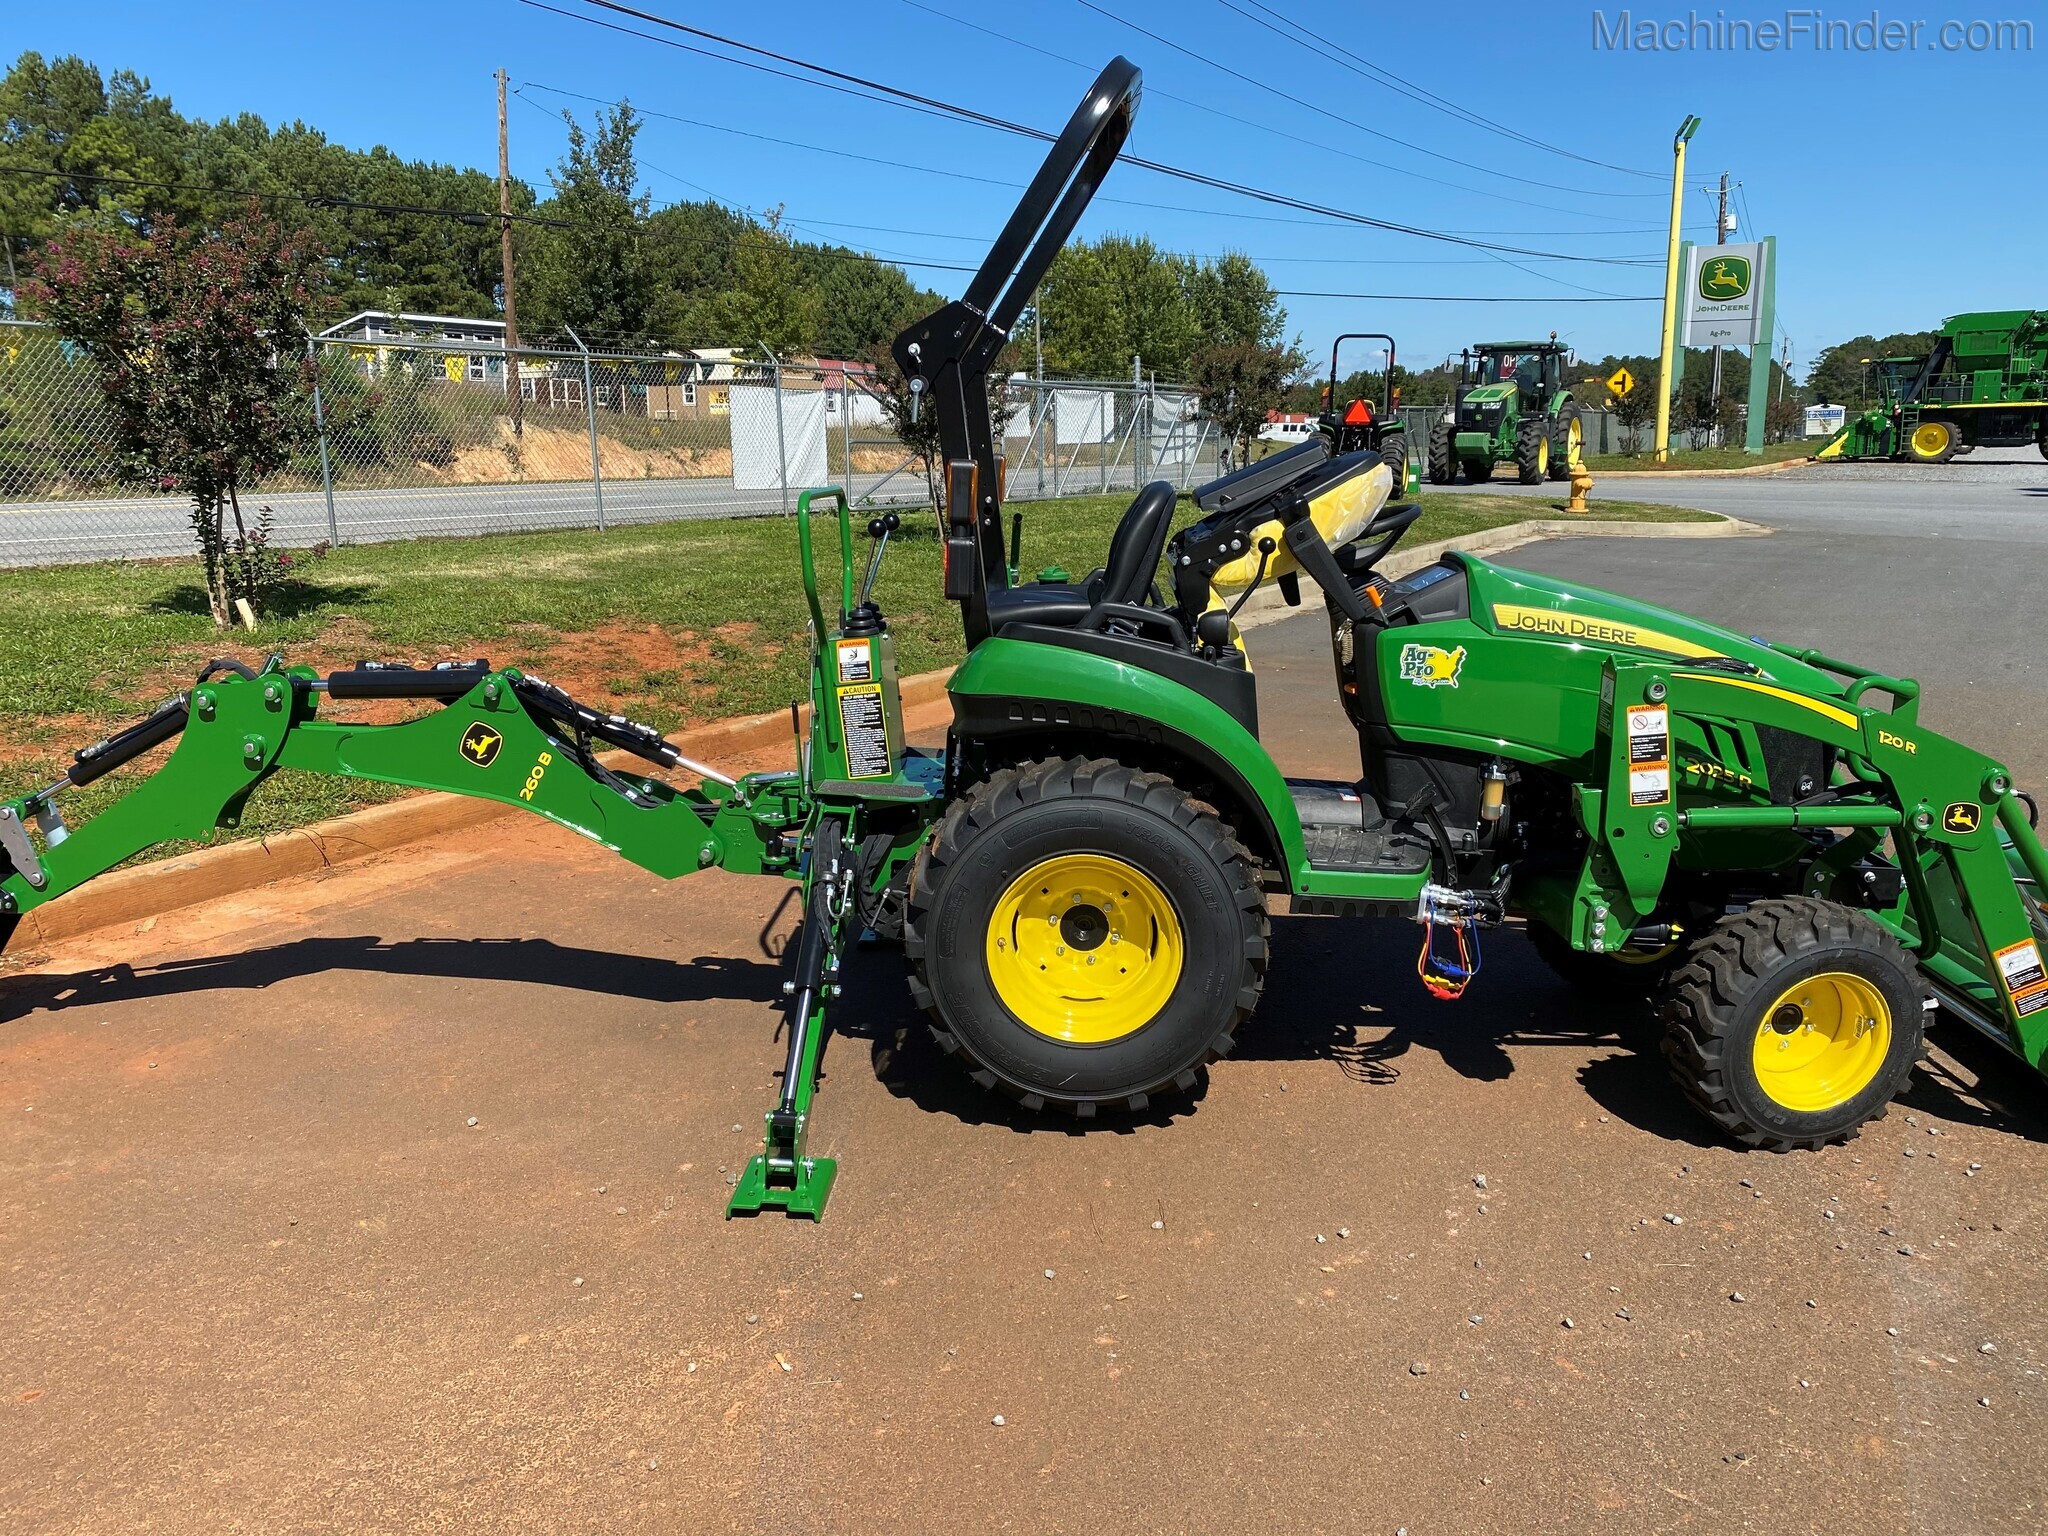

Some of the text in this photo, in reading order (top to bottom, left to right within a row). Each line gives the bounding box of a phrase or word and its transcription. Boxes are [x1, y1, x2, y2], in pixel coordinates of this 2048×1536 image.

[1503, 355, 1515, 367] OP
[1510, 612, 1637, 644] JOHN DEERE
[1404, 647, 1433, 664] Ag-
[1404, 662, 1434, 676] Pro
[848, 686, 876, 694] CAUTION
[1878, 730, 1916, 755] 120 R
[519, 751, 552, 801] 260 B
[1686, 757, 1752, 791] 2025 R
[2005, 941, 2029, 954] WARNING
[2022, 984, 2047, 997] WARNING
